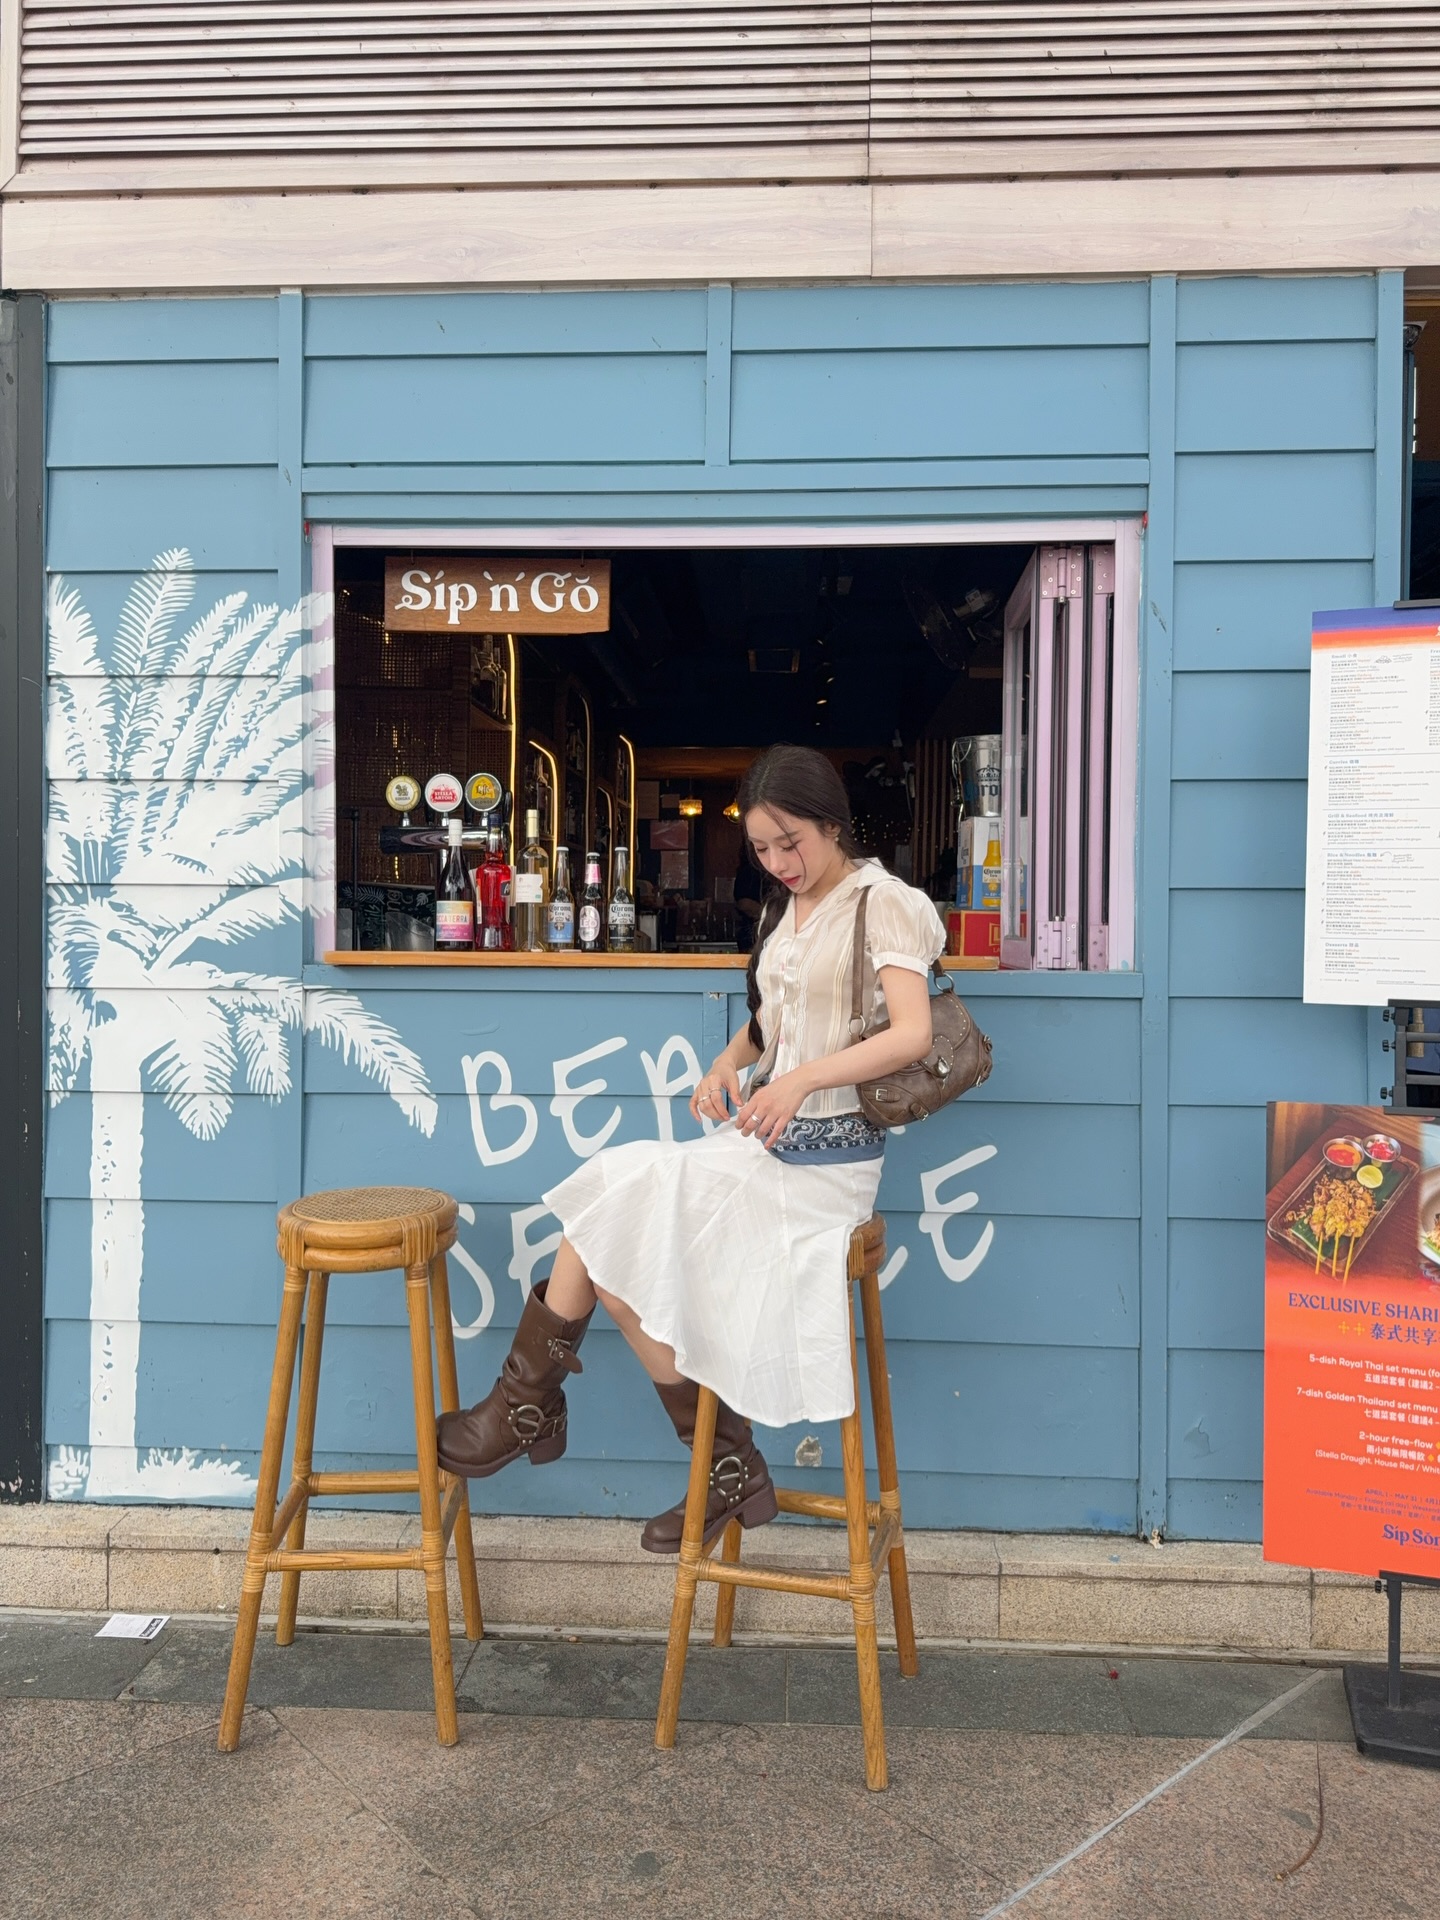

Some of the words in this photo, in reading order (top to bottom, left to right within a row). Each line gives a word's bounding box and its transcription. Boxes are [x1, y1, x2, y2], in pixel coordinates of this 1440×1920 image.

[1288, 1292, 1381, 1317] EXCLUSIVE
[1371, 1322, 1440, 1346] 泰式共享
[1309, 1354, 1336, 1365] 5-dish
[1339, 1357, 1363, 1369] Royal
[1365, 1360, 1384, 1371] Thai
[1385, 1364, 1399, 1373] set
[1401, 1367, 1426, 1376] menu
[1297, 1386, 1323, 1398] 7-dish
[1325, 1390, 1356, 1402] Golden
[1357, 1394, 1395, 1408] Thailand
[1397, 1401, 1411, 1410] set
[1413, 1404, 1438, 1414] menu
[1359, 1431, 1390, 1443] 2-hour
[1391, 1436, 1433, 1449] free-flow
[1315, 1449, 1340, 1460] (Stella
[1374, 1459, 1398, 1469] House
[1399, 1461, 1415, 1471] Red
[1395, 1492, 1409, 1500] MAY
